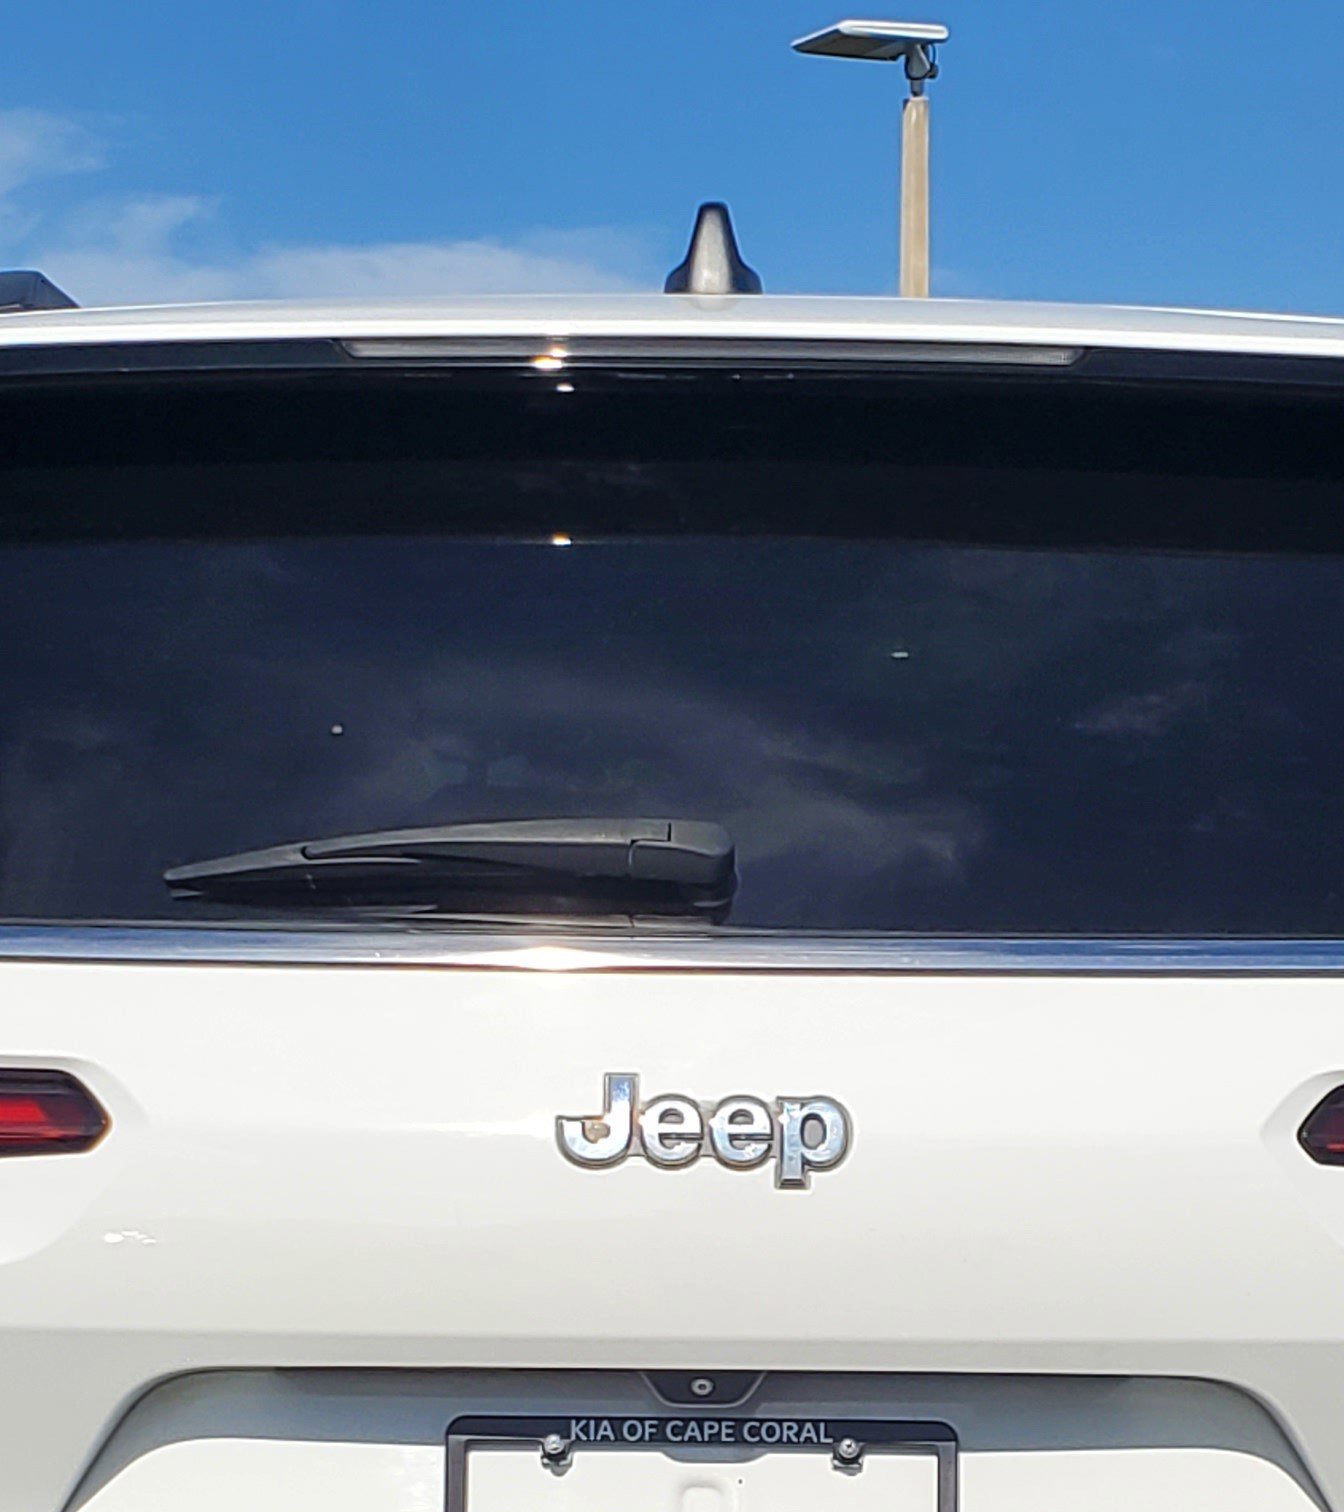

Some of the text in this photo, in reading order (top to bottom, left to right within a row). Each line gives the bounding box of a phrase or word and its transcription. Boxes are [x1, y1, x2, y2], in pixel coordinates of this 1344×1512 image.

[555, 1072, 854, 1189] Jeep
[571, 1419, 834, 1443] KIA OF CAPE CORAL
